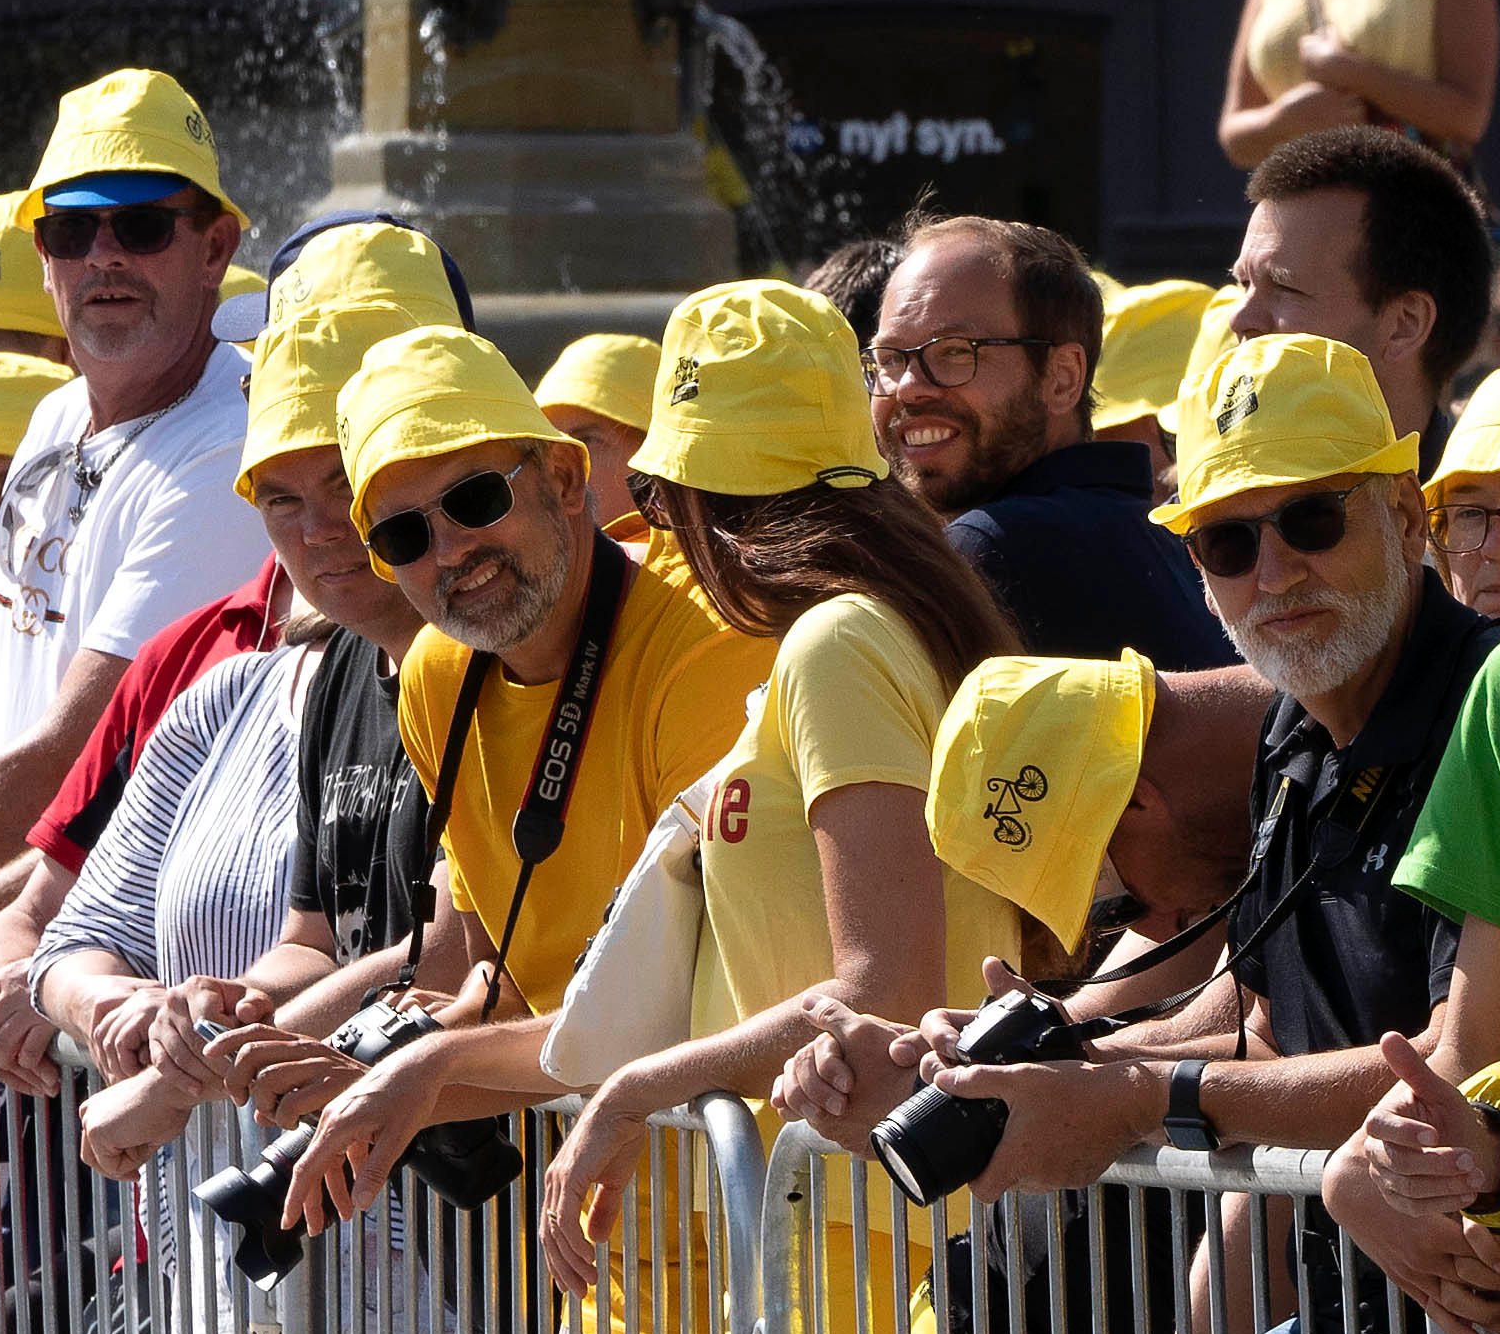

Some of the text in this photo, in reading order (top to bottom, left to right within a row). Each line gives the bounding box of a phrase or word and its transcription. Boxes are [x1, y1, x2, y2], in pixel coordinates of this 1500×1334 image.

[838, 110, 1005, 163] nyt syn.
[538, 639, 600, 802] EOS 5D Mark IV
[1350, 765, 1384, 803] Nik
